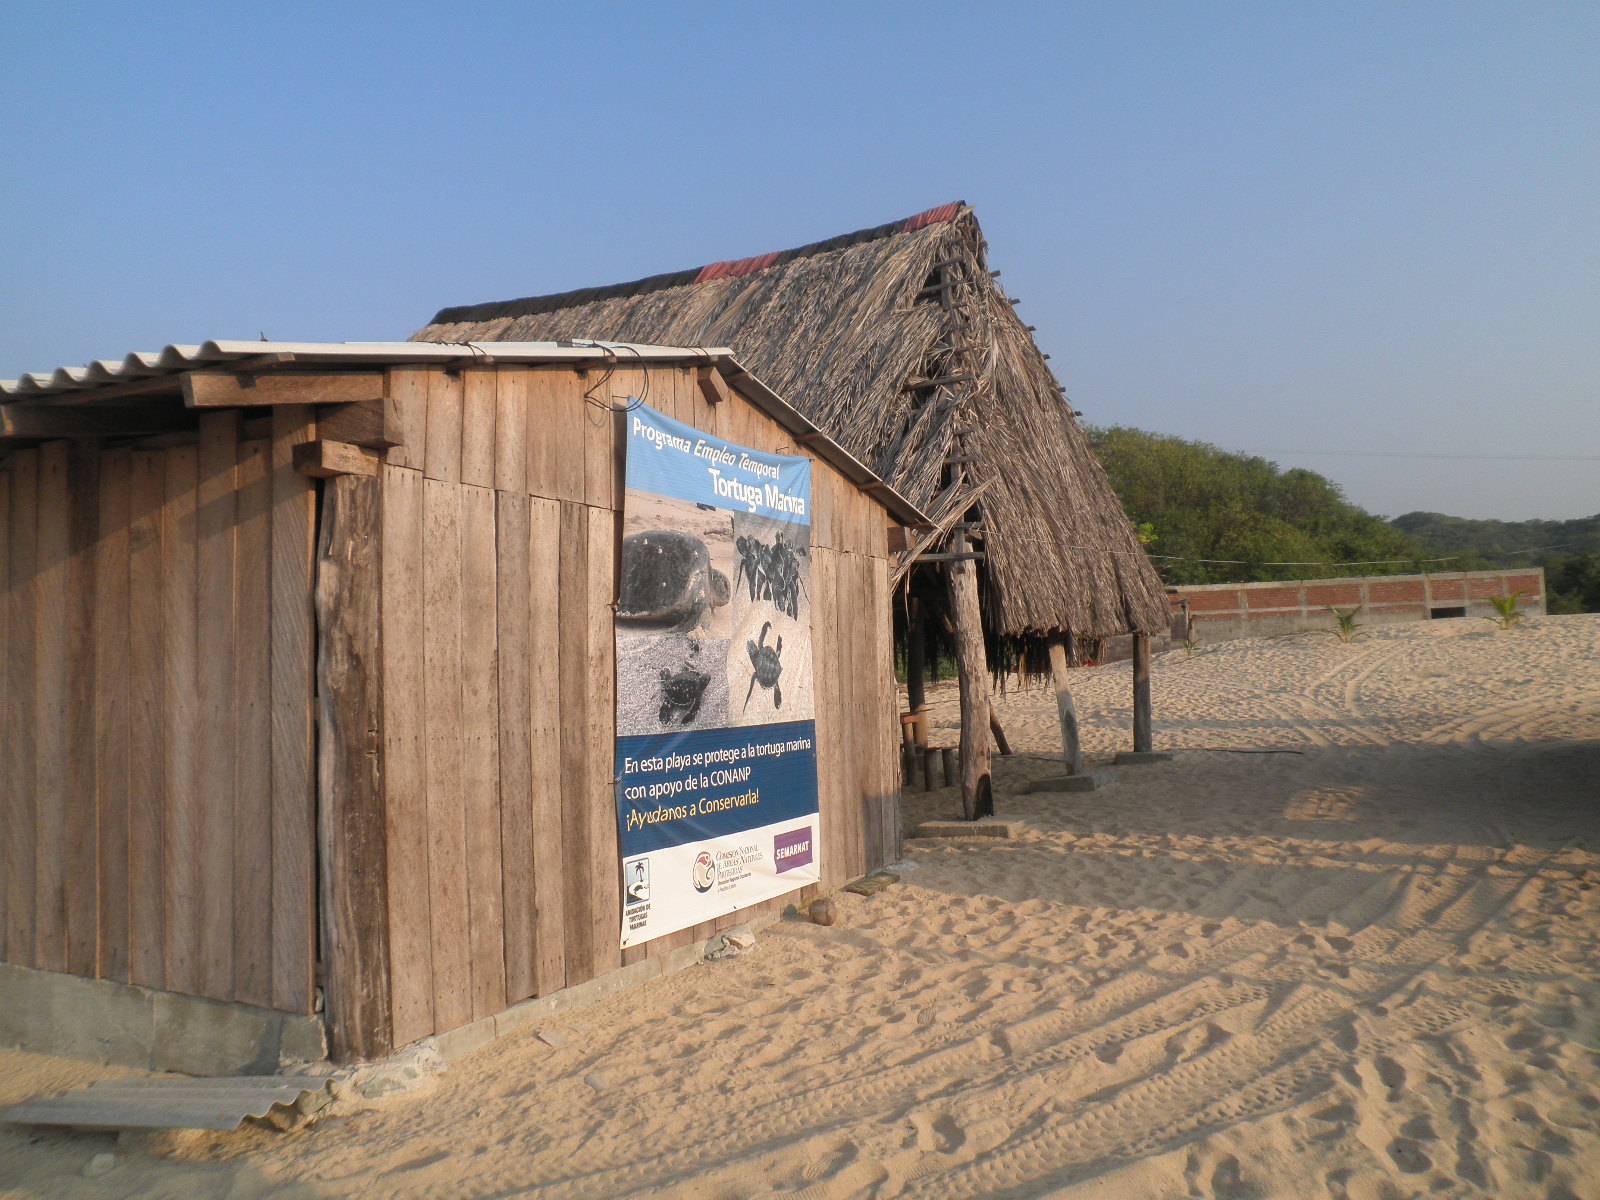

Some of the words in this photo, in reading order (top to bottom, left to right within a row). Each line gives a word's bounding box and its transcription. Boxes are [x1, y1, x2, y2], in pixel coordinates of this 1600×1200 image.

[633, 416, 690, 453] Programa
[693, 439, 737, 466] Empleo
[739, 453, 780, 480] Temporal
[708, 468, 763, 513] Tortuga
[765, 483, 805, 515] Marina
[624, 757, 639, 774] En
[641, 755, 663, 771] esta
[665, 752, 691, 773] playa
[692, 752, 703, 765] se
[704, 746, 740, 767] protege
[741, 747, 747, 758] a
[748, 743, 755, 757] la
[756, 741, 785, 757] tortuga
[786, 737, 811, 751] marina
[624, 786, 647, 800] con
[649, 781, 683, 801] apoyo
[685, 775, 698, 792] de
[700, 773, 709, 788] la
[710, 767, 751, 786] CONANP
[689, 803, 696, 815] a
[698, 788, 759, 814] Conservarla!
[776, 841, 810, 860] SEMARNAT
